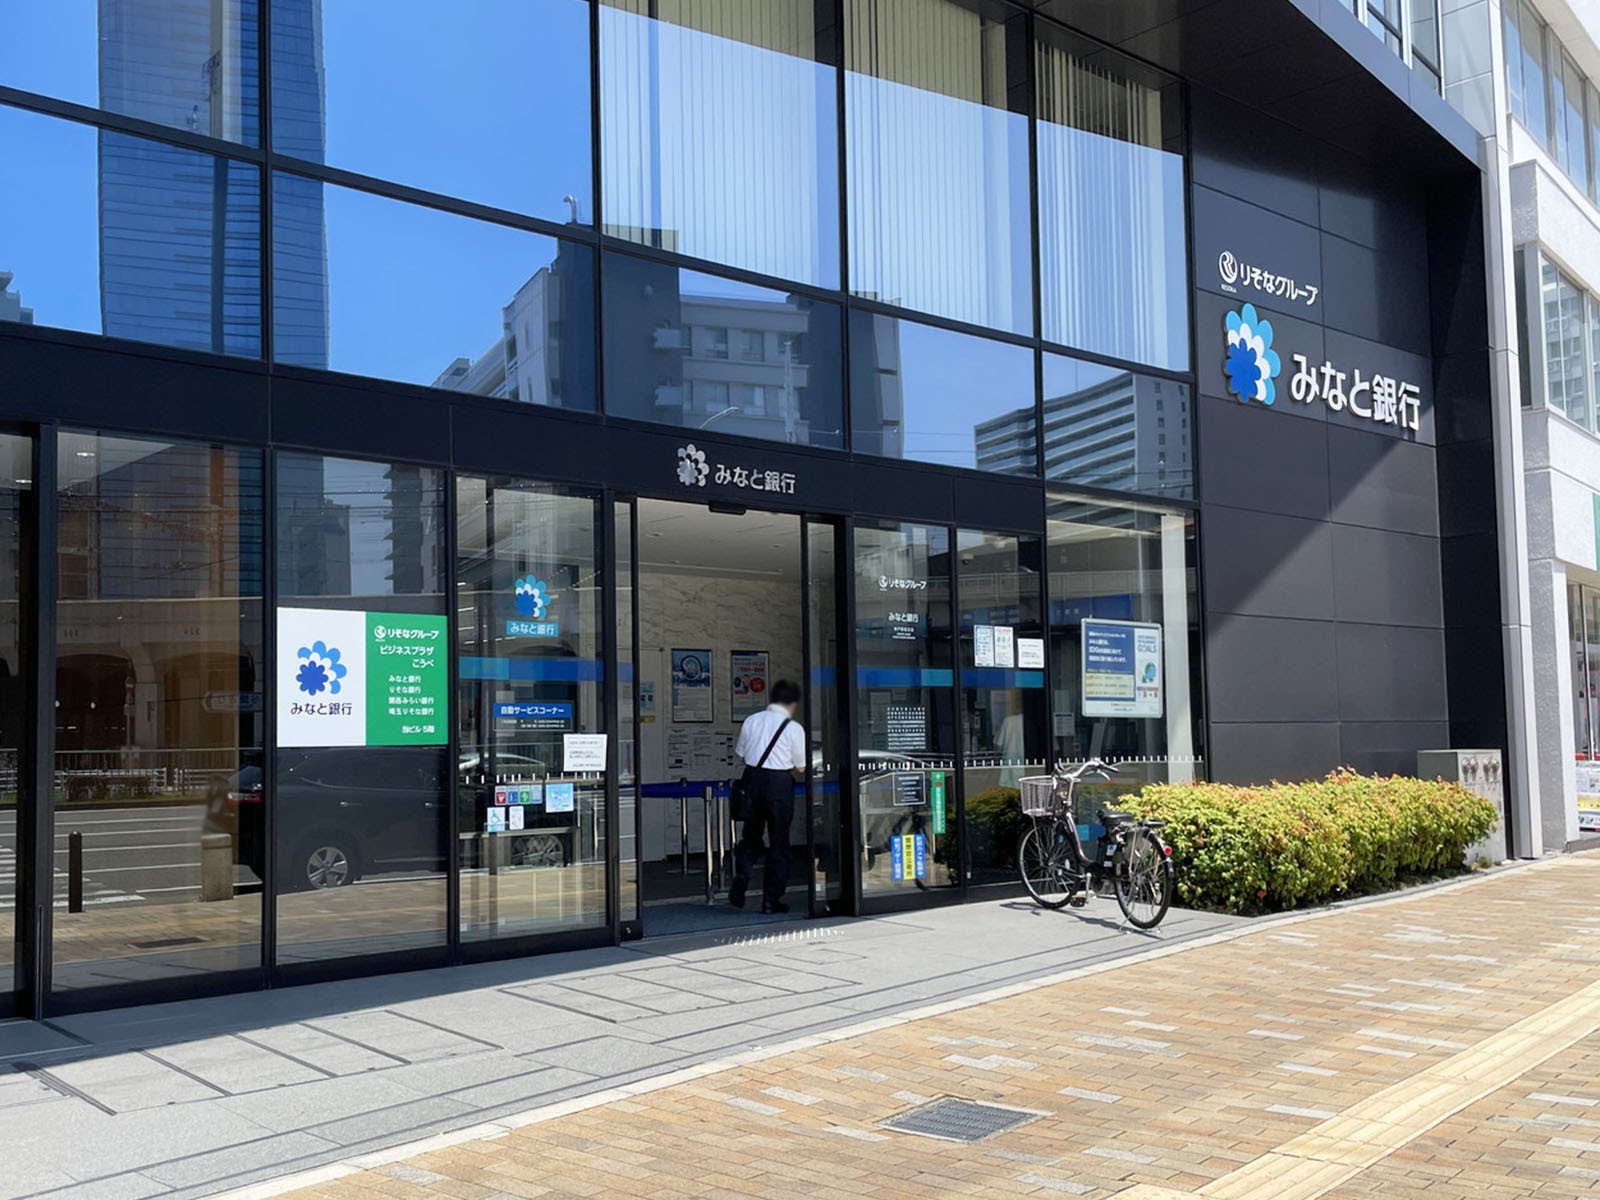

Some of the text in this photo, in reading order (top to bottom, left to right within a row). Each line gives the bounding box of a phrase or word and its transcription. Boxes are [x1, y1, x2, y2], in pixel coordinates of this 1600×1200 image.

[1240, 263, 1318, 305] りそなグループ
[1291, 353, 1421, 431] みなと銀行
[714, 464, 796, 494] みなと銀行
[888, 578, 927, 590] りそなグループ
[387, 628, 440, 640] りそなグループ
[510, 623, 555, 635] みなと銀行
[380, 645, 434, 656] ビジネスプラザ
[412, 658, 435, 668] こうべ
[388, 675, 421, 683] みなと銀行
[389, 686, 421, 694] りそな銀行
[290, 702, 353, 716] みなと銀行
[500, 705, 565, 715] 自動サービスコーナー
